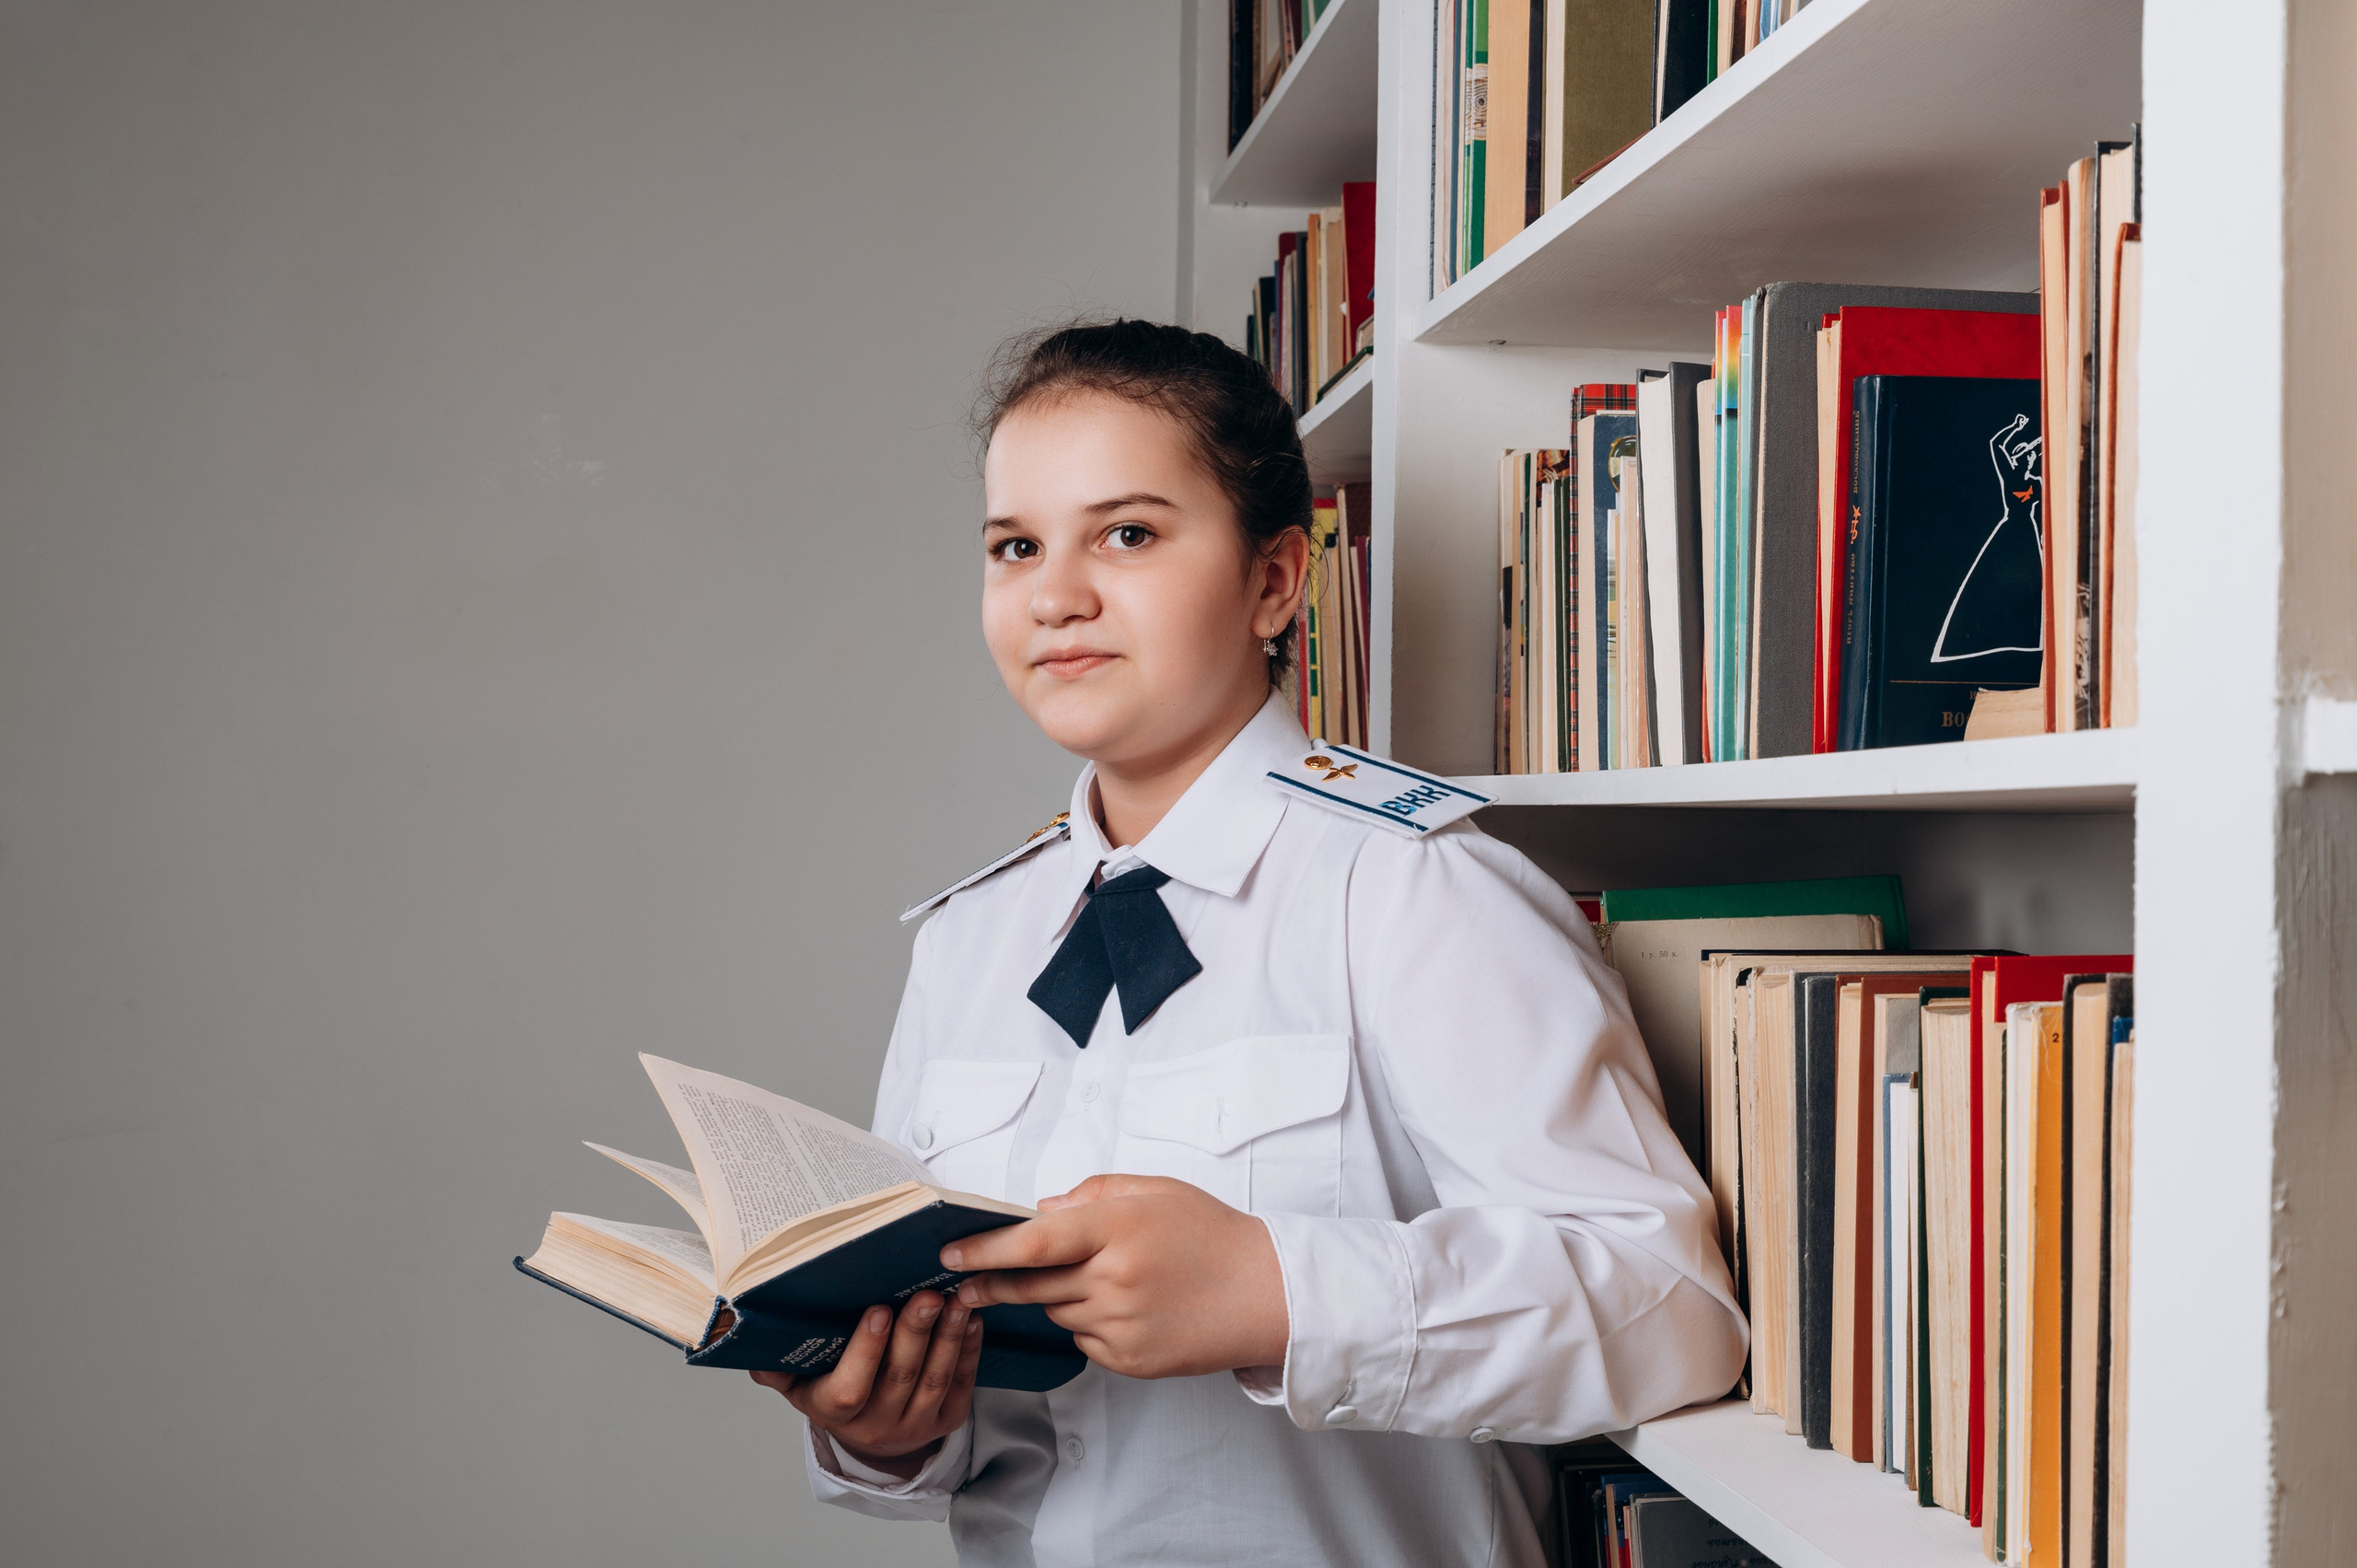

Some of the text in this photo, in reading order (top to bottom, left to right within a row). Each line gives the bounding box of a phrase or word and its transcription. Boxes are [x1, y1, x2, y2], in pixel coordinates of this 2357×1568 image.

[2052, 1032, 2060, 1042] 2
[780, 1338, 817, 1364] ЛЕОНИД
[790, 1339, 825, 1365] ЛЕОНОВ
[801, 1337, 845, 1368] РУССКИЙ
